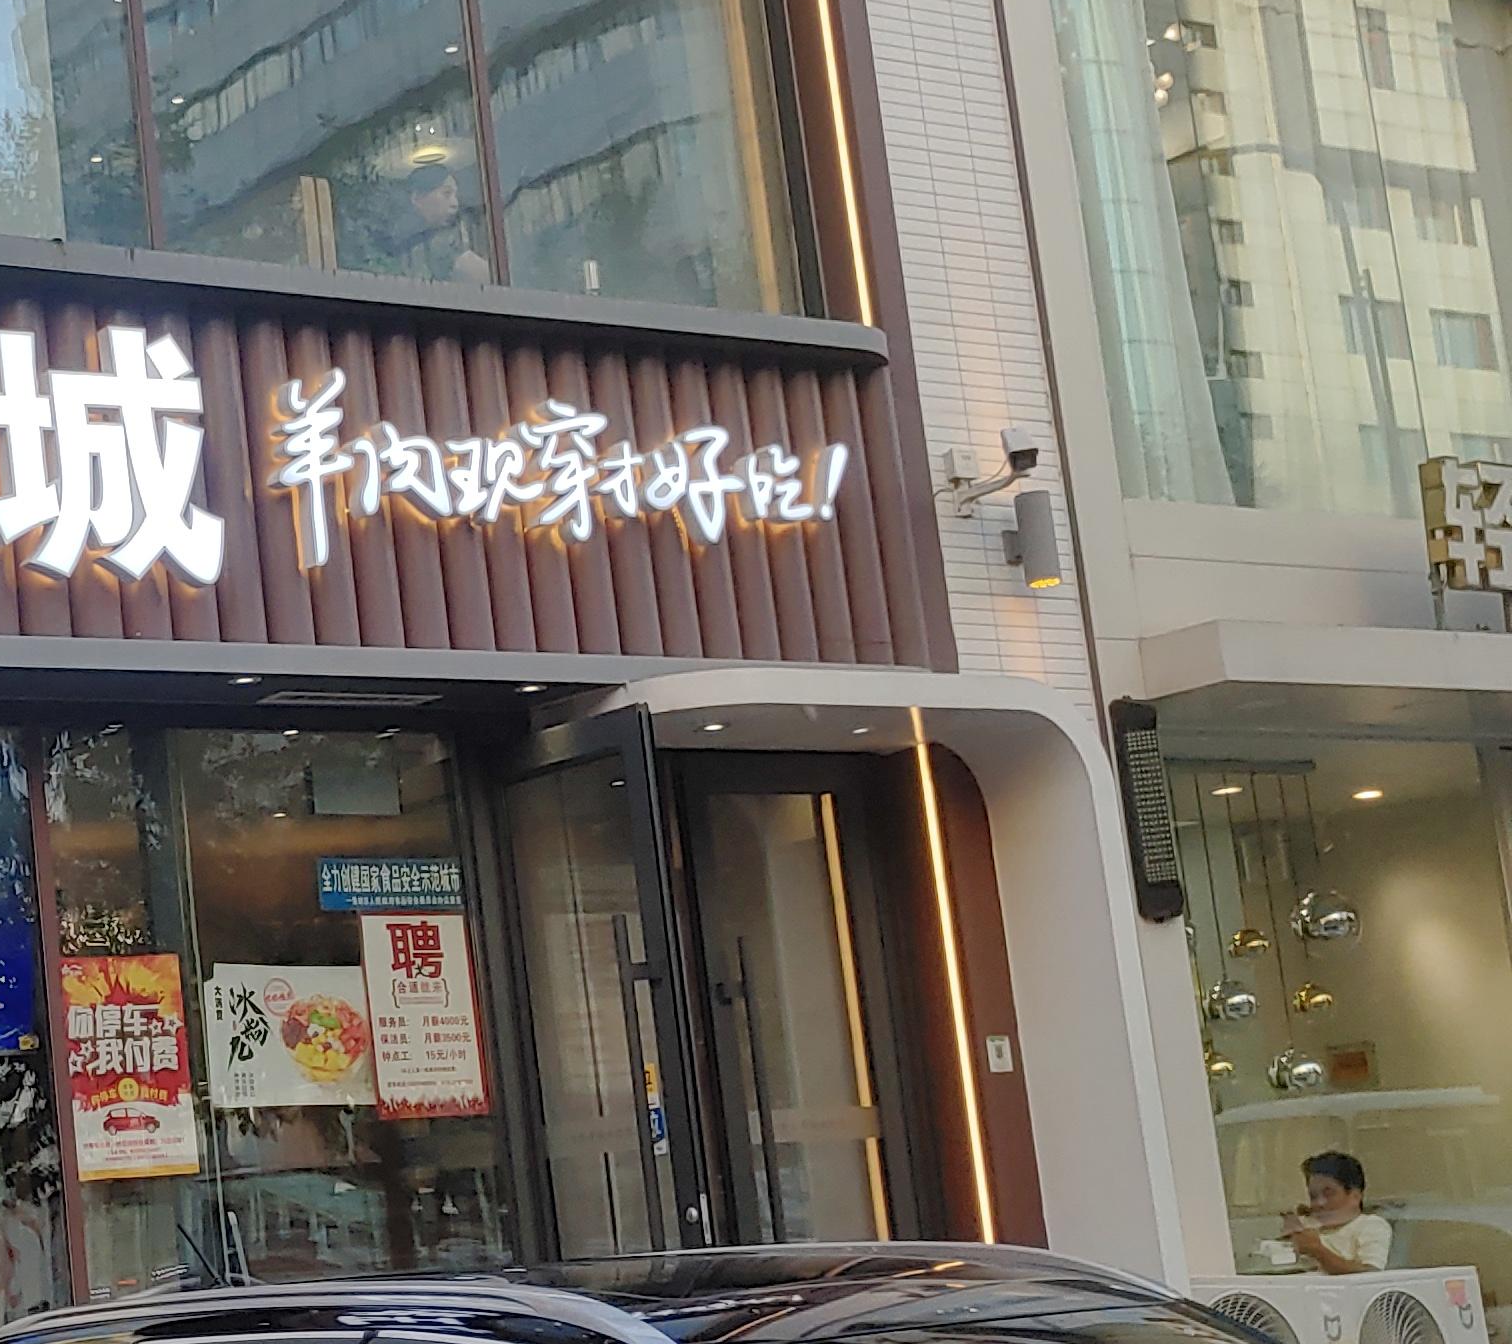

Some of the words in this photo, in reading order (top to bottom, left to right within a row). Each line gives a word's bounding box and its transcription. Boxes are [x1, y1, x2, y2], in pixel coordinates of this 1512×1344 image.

[321, 863, 461, 893] 全力创建国家食品安全示范城市
[386, 921, 444, 978] 聘
[67, 1003, 161, 1040] 你停车
[87, 1035, 179, 1075] 我付费
